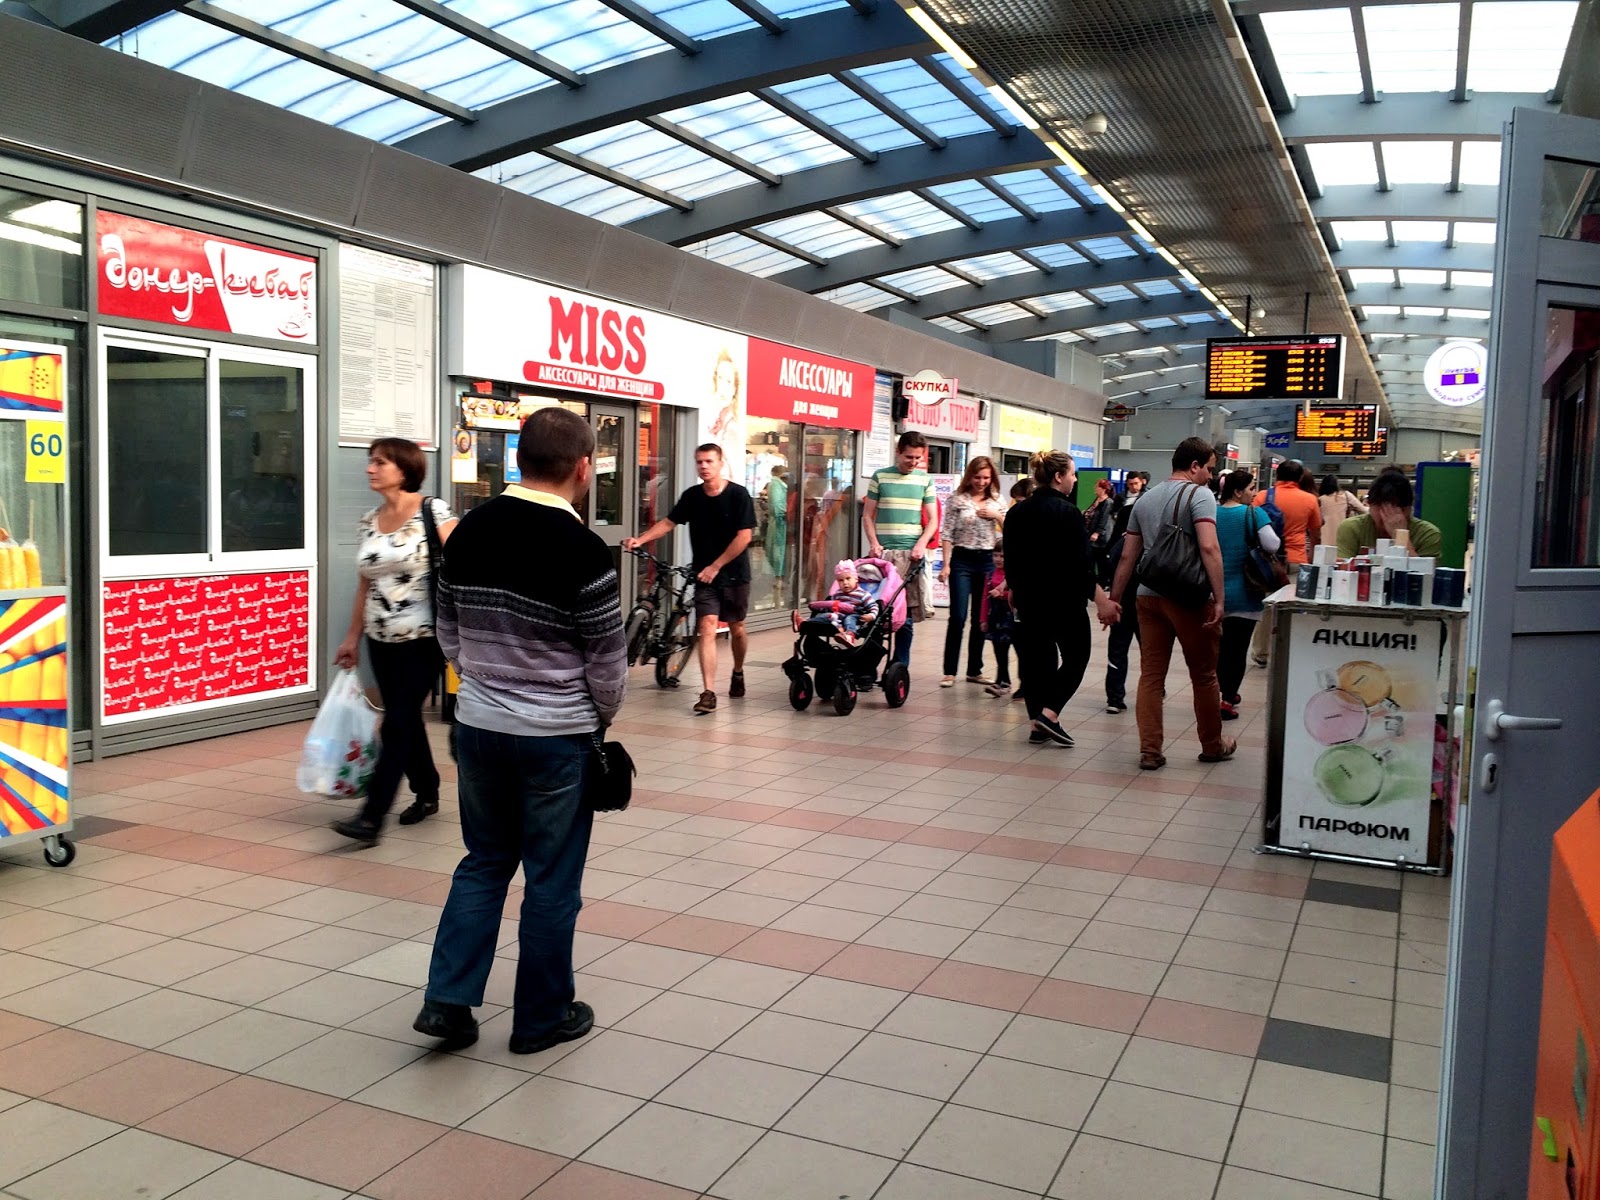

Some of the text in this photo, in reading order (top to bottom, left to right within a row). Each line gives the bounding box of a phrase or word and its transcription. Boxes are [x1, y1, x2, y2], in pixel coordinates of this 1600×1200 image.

[548, 295, 647, 375] MISS
[538, 365, 655, 397] АКСЕССУАРЫ ДЛЯ ЖЕНЩИН
[779, 357, 853, 398] АКСЕССУАРЫ
[905, 380, 950, 393] СКУПКА
[950, 403, 976, 433] VIDEO
[30, 433, 63, 457] 60
[1312, 628, 1418, 650] АКЦИЯ!
[1299, 815, 1411, 841] ПАРФЮМ
